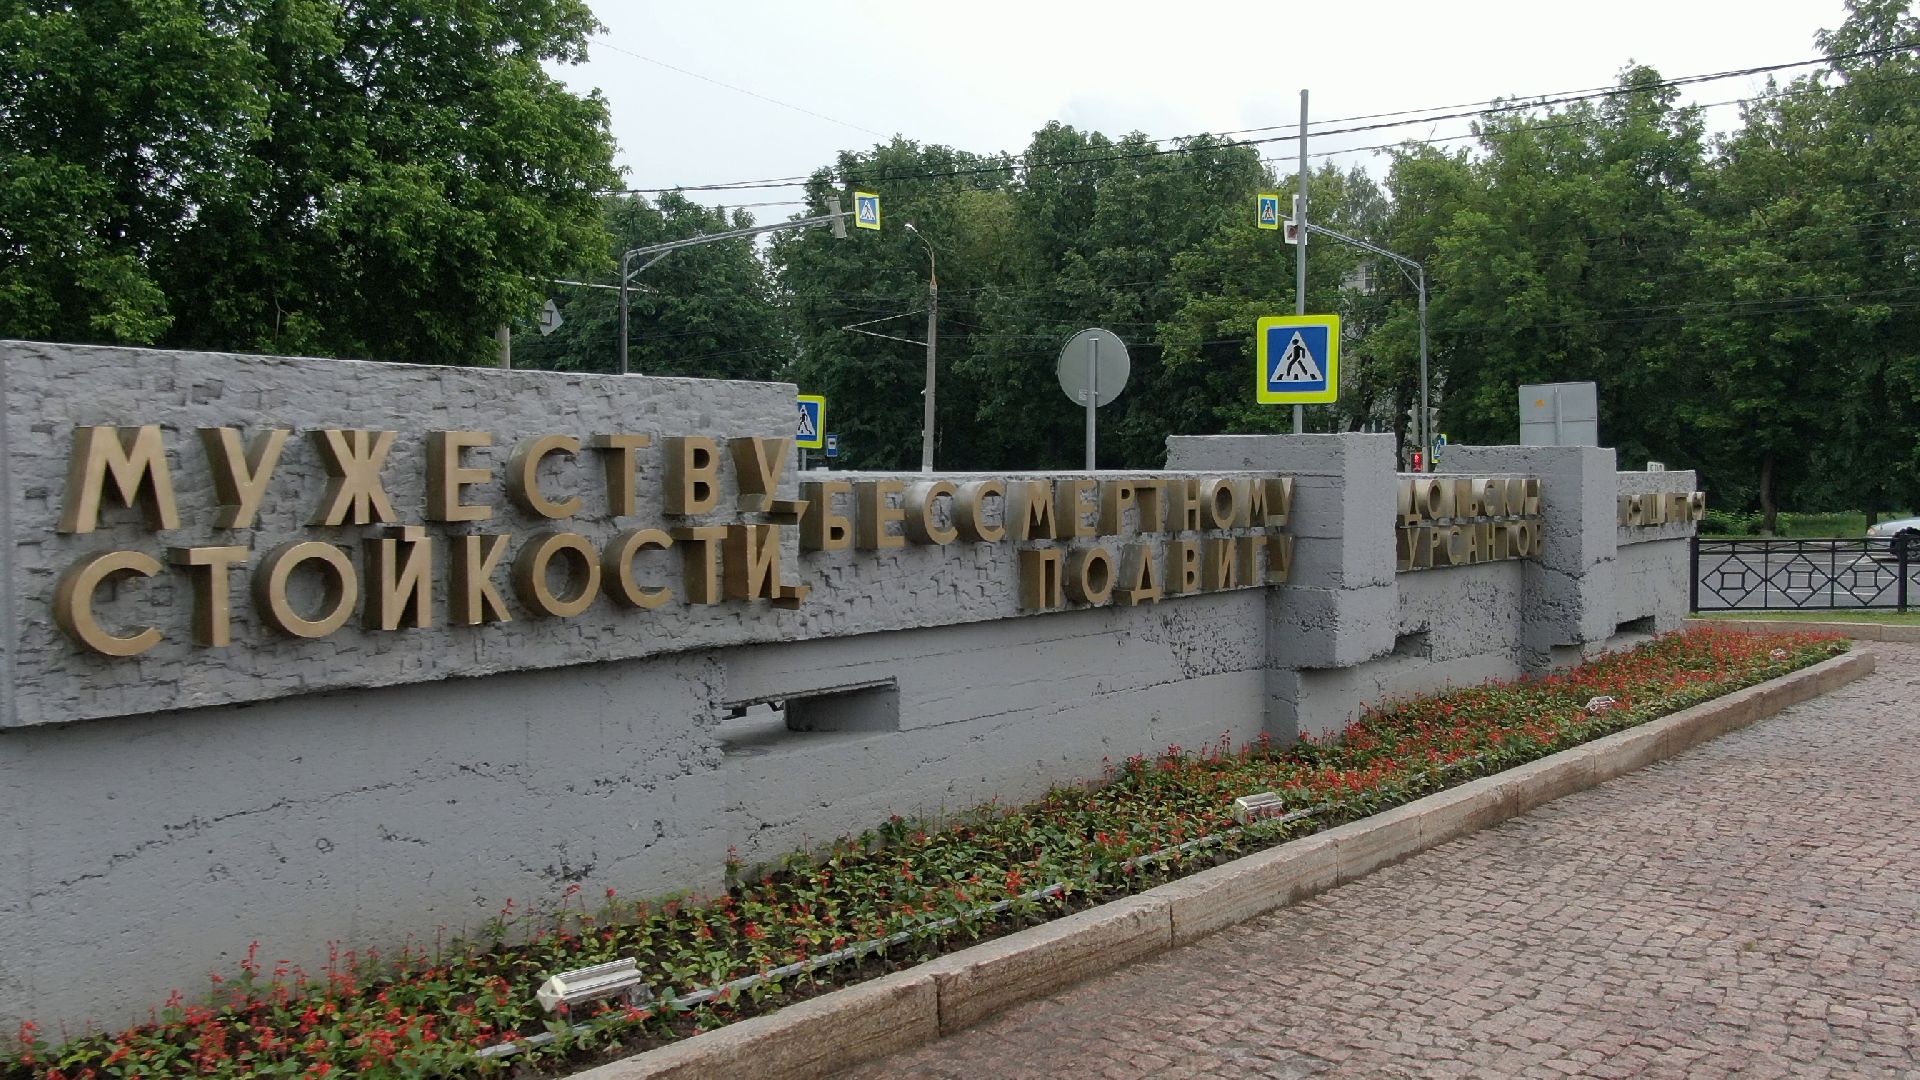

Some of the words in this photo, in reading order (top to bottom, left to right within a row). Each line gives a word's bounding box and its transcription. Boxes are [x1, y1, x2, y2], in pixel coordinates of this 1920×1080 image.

[59, 425, 808, 534] МУЖЕСТВУ,
[801, 478, 1296, 551] БЕССМЕРТНОМУ
[54, 524, 809, 657] СТОЙКОСТИ,
[1019, 535, 1296, 609] ПОДВИГУ
